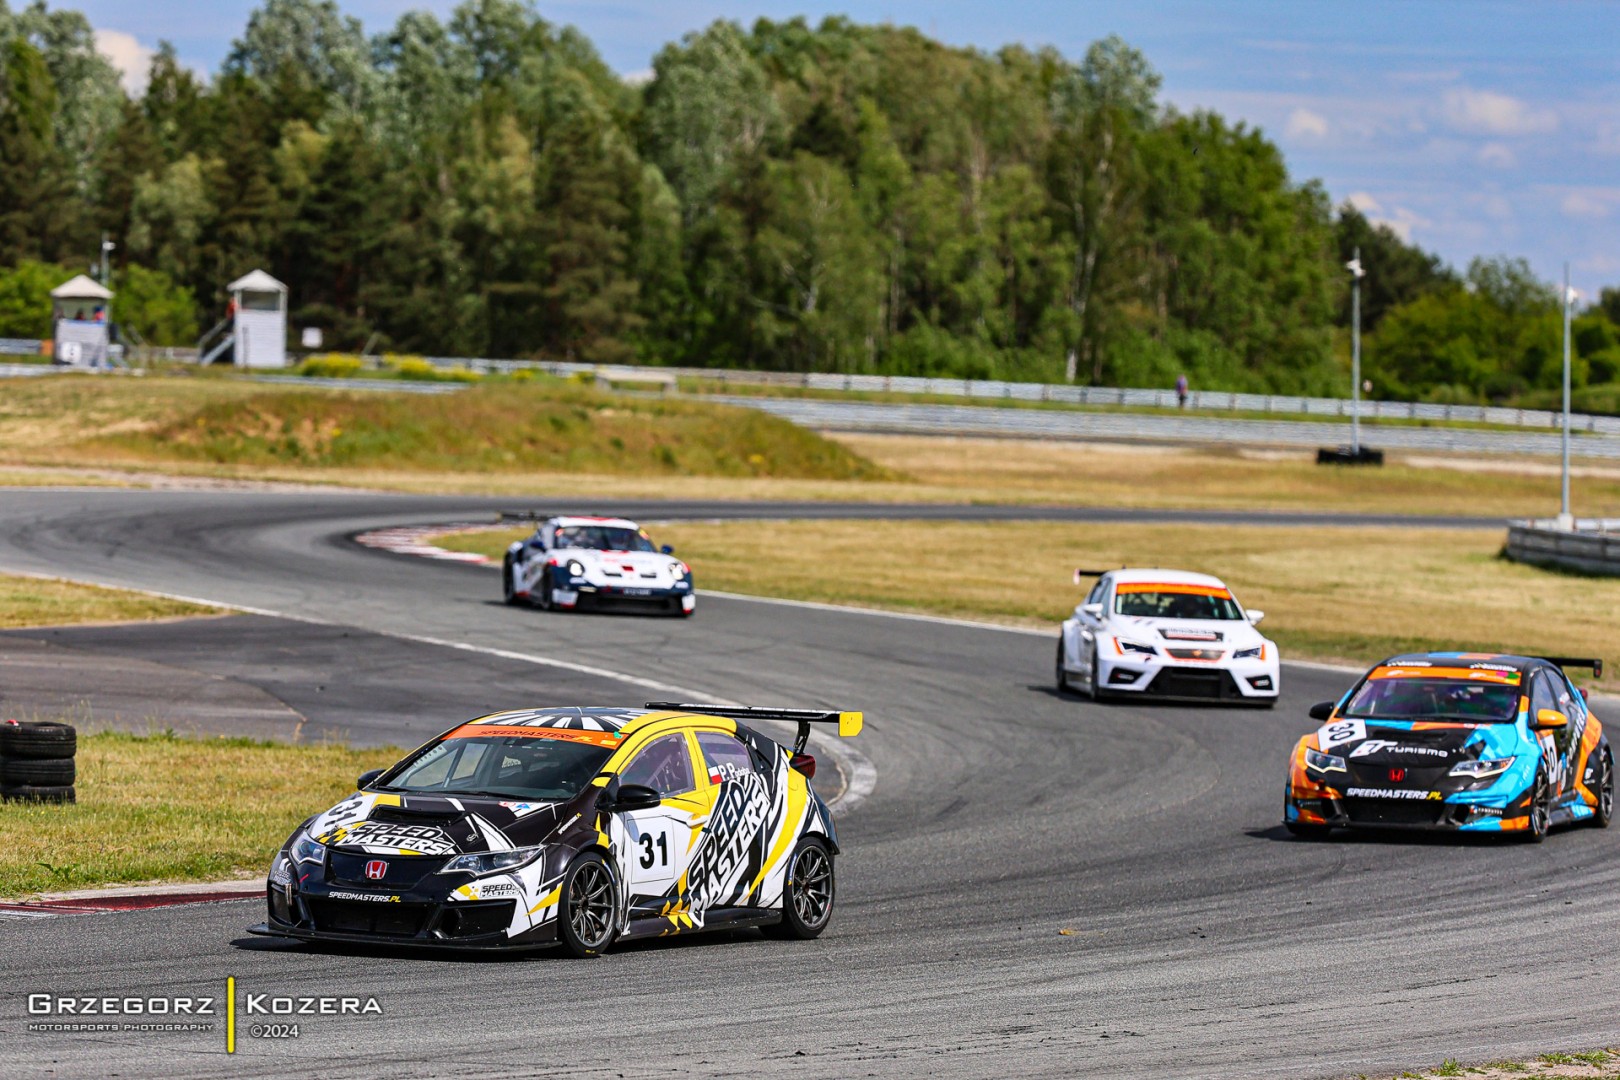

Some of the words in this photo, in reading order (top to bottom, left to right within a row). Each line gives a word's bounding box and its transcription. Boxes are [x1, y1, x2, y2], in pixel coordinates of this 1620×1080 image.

[1328, 722, 1355, 741] 30
[1386, 746, 1449, 758] TURISMO
[1346, 787, 1443, 800] SPEEDMASTERS.PL
[324, 800, 363, 827] 31
[354, 824, 438, 840] SPEED
[688, 779, 746, 889] SPEED
[337, 833, 454, 855] MASTERS
[638, 830, 667, 870] 31
[689, 782, 771, 928] MASTERS
[328, 891, 402, 903] SPEEDMASTERS.PL
[481, 883, 514, 892] SPEED
